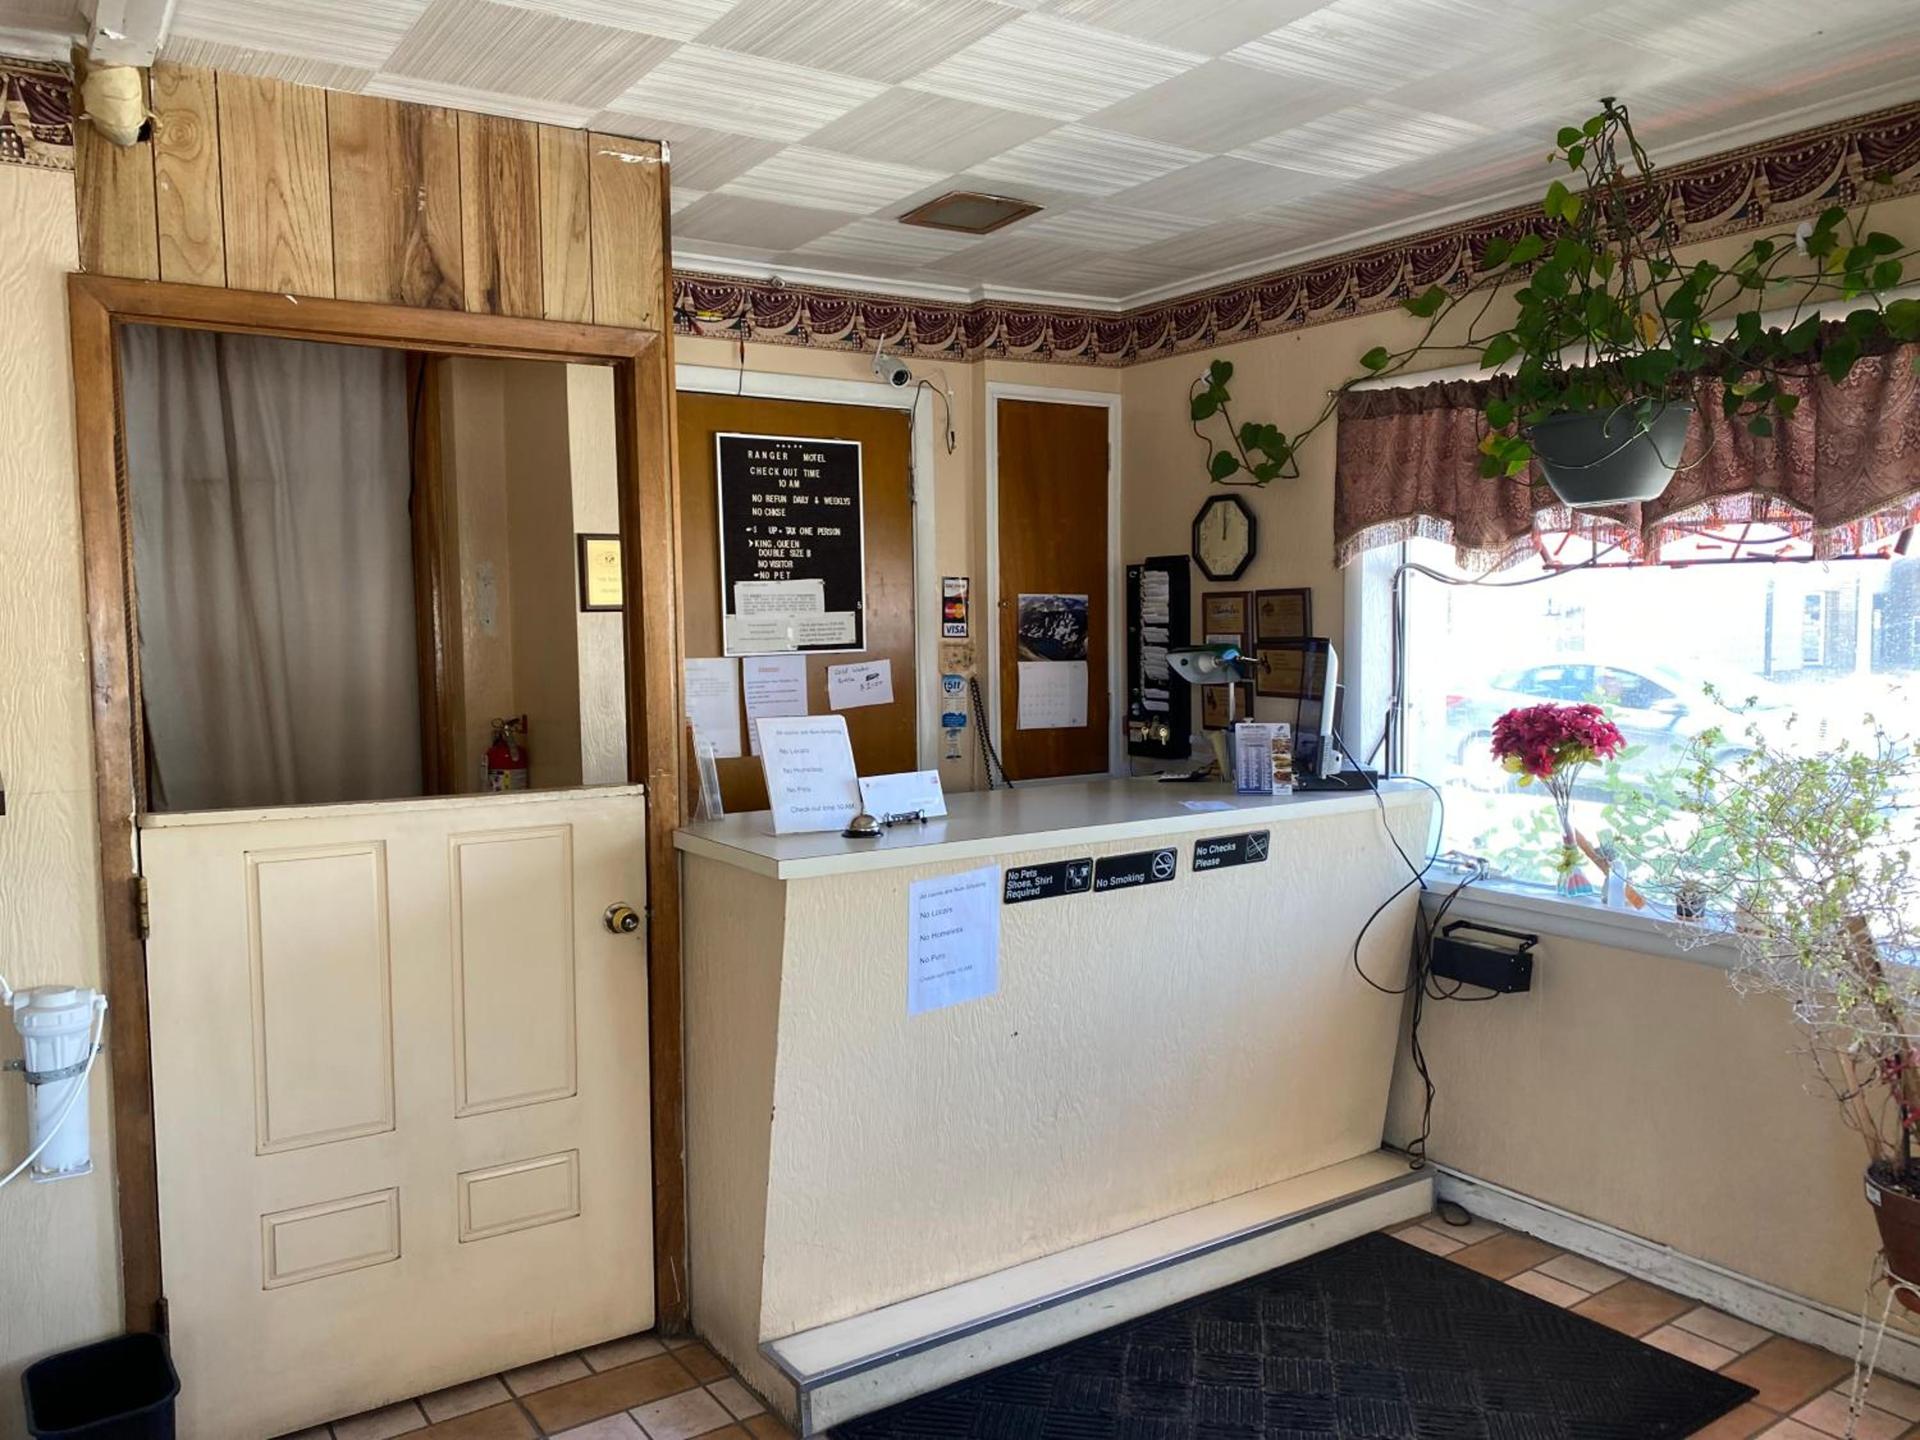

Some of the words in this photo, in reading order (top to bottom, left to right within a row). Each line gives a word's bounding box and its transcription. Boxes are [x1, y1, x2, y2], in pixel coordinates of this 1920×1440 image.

[747, 450, 788, 460] RANGER
[803, 453, 826, 463] MOTEL
[749, 466, 780, 476] CHECK
[782, 468, 798, 477] OUT
[803, 469, 821, 478] TIME
[779, 479, 787, 488] 10
[788, 479, 800, 488] AM
[752, 494, 763, 503] NO
[765, 494, 787, 503] REFUN
[752, 507, 763, 516] NO
[799, 527, 814, 536] ONE
[817, 527, 841, 536] PERSON
[758, 549, 785, 557] DOUBLE
[789, 549, 804, 558] SIZE
[757, 560, 769, 568] NO
[769, 560, 794, 568] VISITOR
[760, 571, 770, 579] NO
[774, 571, 791, 579] PET
[946, 624, 966, 634] VISA
[1196, 847, 1208, 856] No
[1209, 842, 1237, 855] Checks
[1195, 857, 1220, 869] Please
[1008, 871, 1019, 880] No
[1020, 869, 1038, 878] Pets
[1035, 875, 1053, 886] Shirt
[1096, 878, 1109, 888] No
[1109, 872, 1145, 886] Smoking
[1006, 887, 1041, 899] Required
[920, 911, 930, 919] No
[920, 934, 930, 942] No
[920, 957, 930, 965] No
